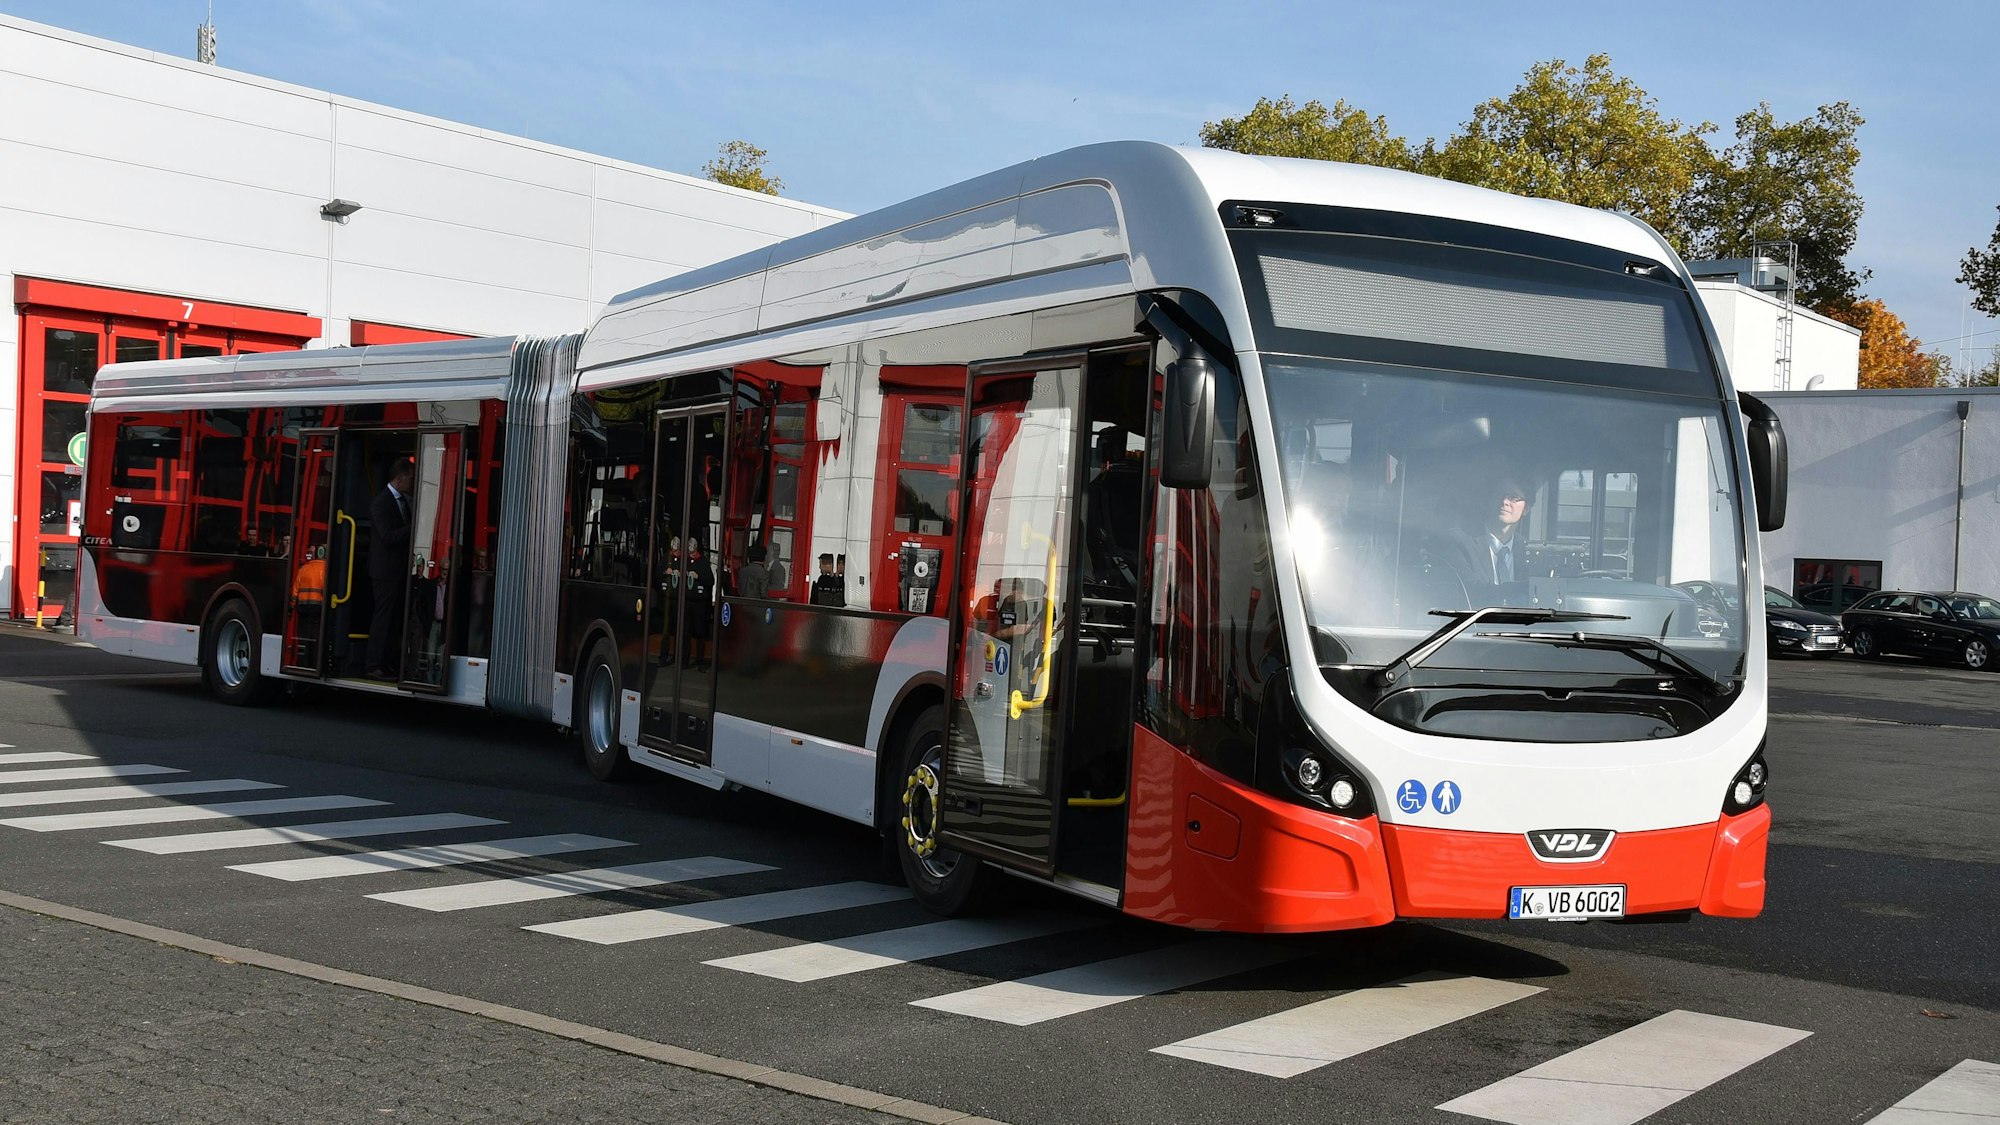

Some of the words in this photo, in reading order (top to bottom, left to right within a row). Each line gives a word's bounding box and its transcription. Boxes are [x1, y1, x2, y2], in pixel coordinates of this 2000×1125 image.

[182, 301, 194, 320] 7
[1539, 833, 1597, 853] VDL
[1522, 892, 1535, 914] K
[1548, 892, 1571, 913] VB
[1575, 891, 1620, 912] 6002
